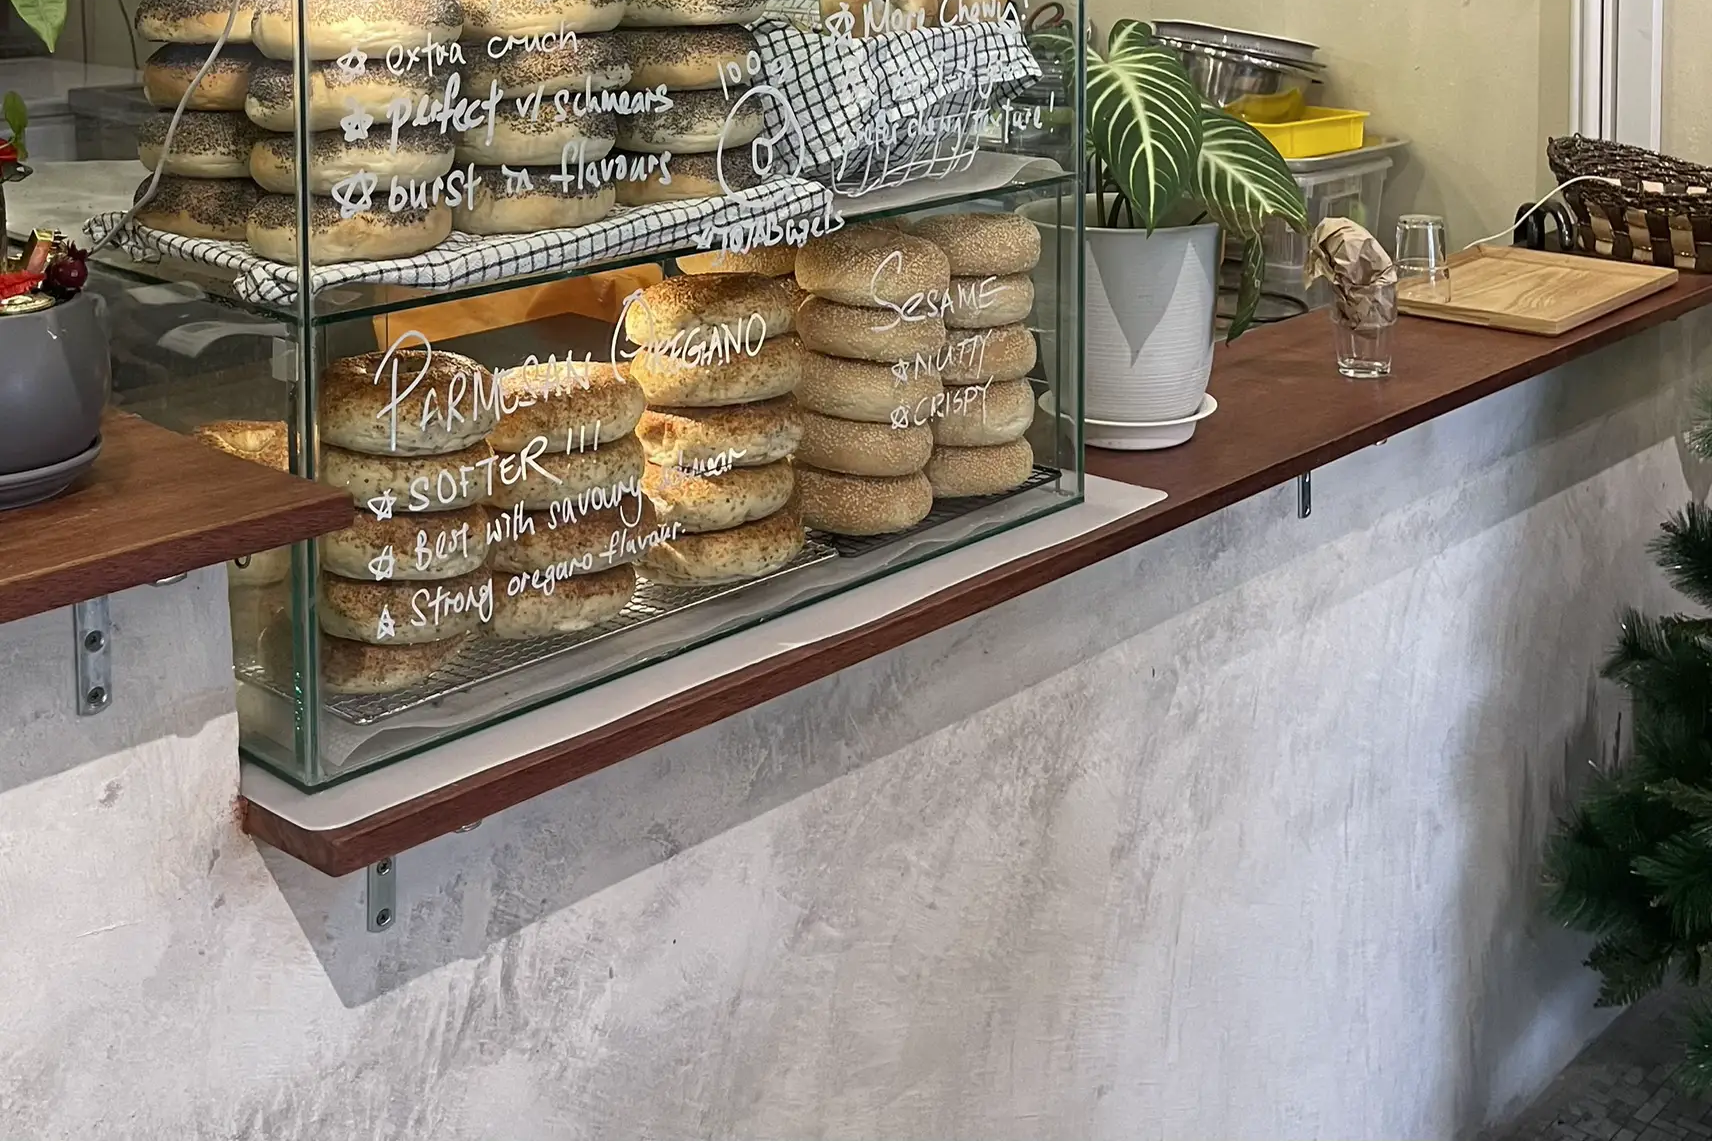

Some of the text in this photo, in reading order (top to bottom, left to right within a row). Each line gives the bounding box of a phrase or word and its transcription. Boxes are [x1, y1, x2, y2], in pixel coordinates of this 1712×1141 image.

[386, 32, 467, 77] extra
[386, 72, 504, 155] perfect
[386, 163, 482, 214] burst
[549, 140, 672, 194] flavours
[914, 329, 993, 380] NUTTY
[914, 375, 994, 426] CRISPY
[408, 434, 563, 513] SOFTER
[415, 528, 470, 572] Best
[486, 506, 536, 546] with
[548, 474, 642, 528] savoury
[411, 577, 494, 628] Strong
[507, 554, 592, 597] oregano
